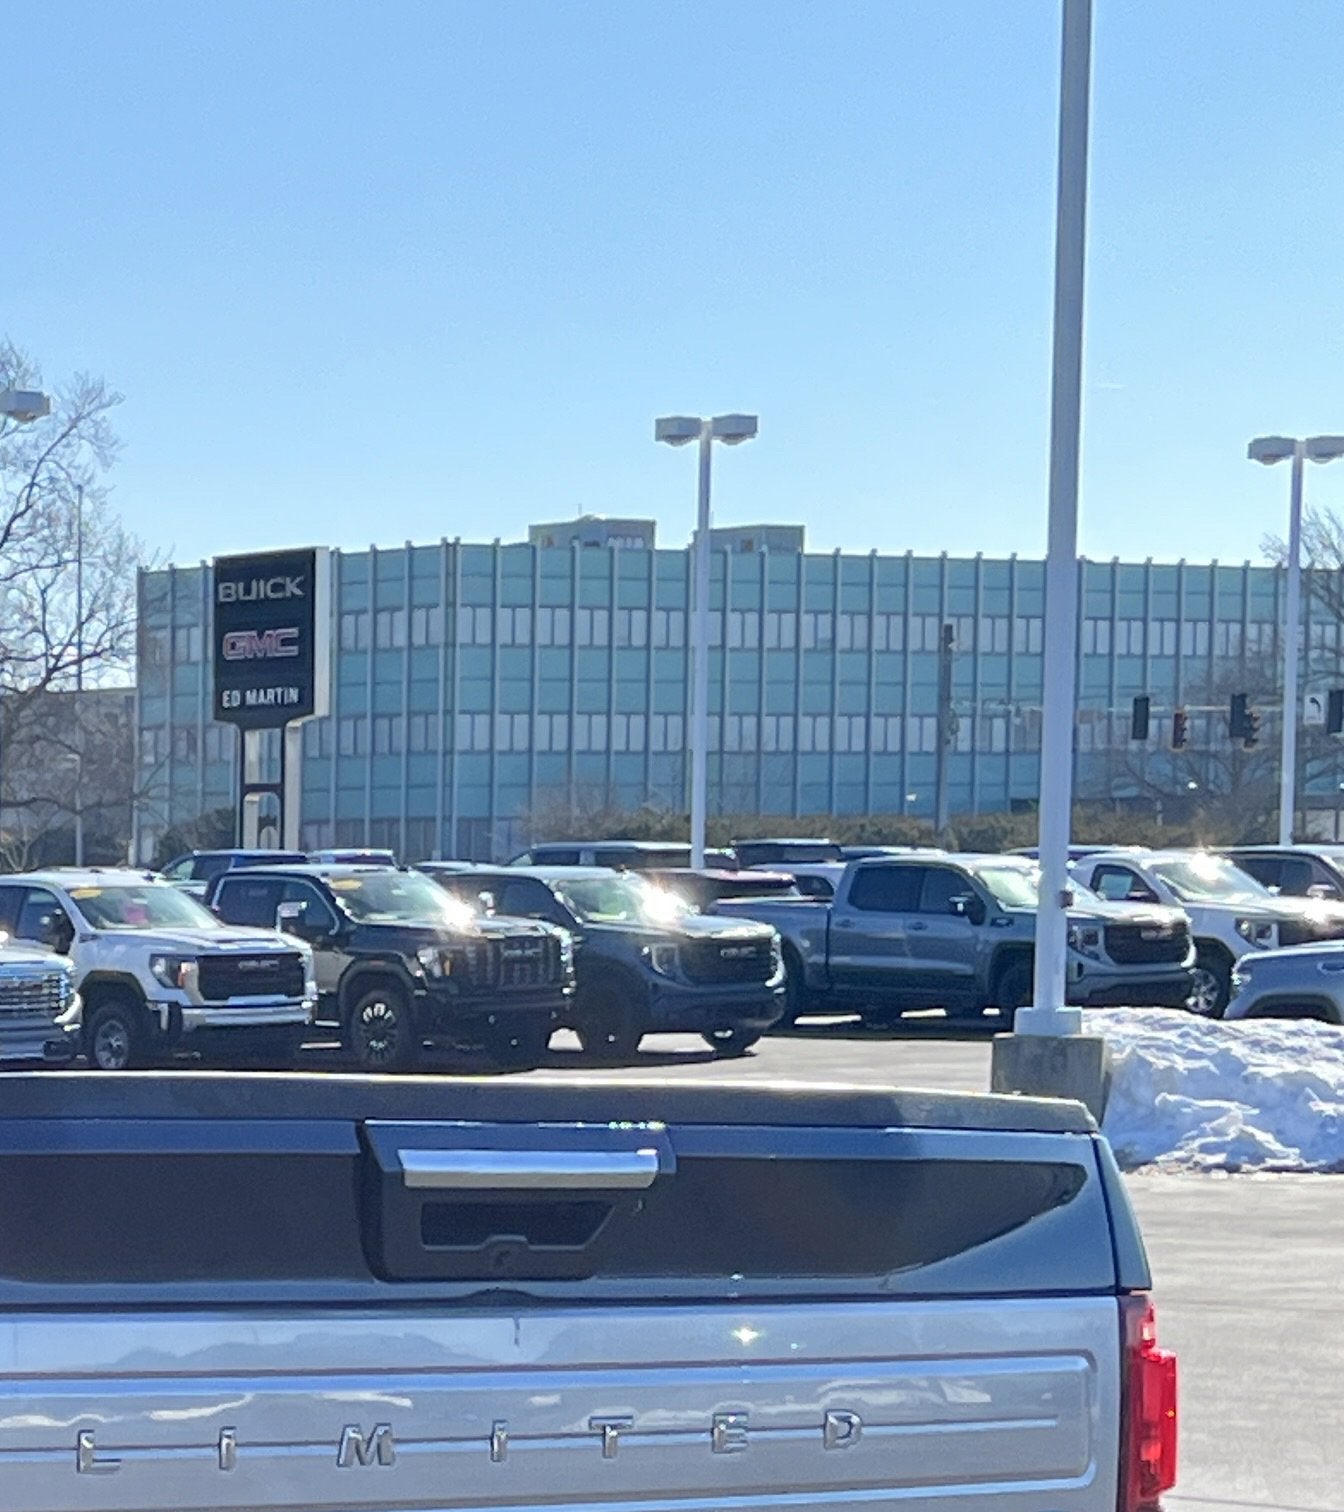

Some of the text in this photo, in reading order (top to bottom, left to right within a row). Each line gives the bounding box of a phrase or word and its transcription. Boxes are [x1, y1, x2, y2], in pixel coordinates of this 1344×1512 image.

[218, 576, 305, 602] BUICK
[223, 627, 299, 661] GMC
[223, 686, 300, 708] ED MARTIN
[75, 1407, 863, 1474] LIMITED
